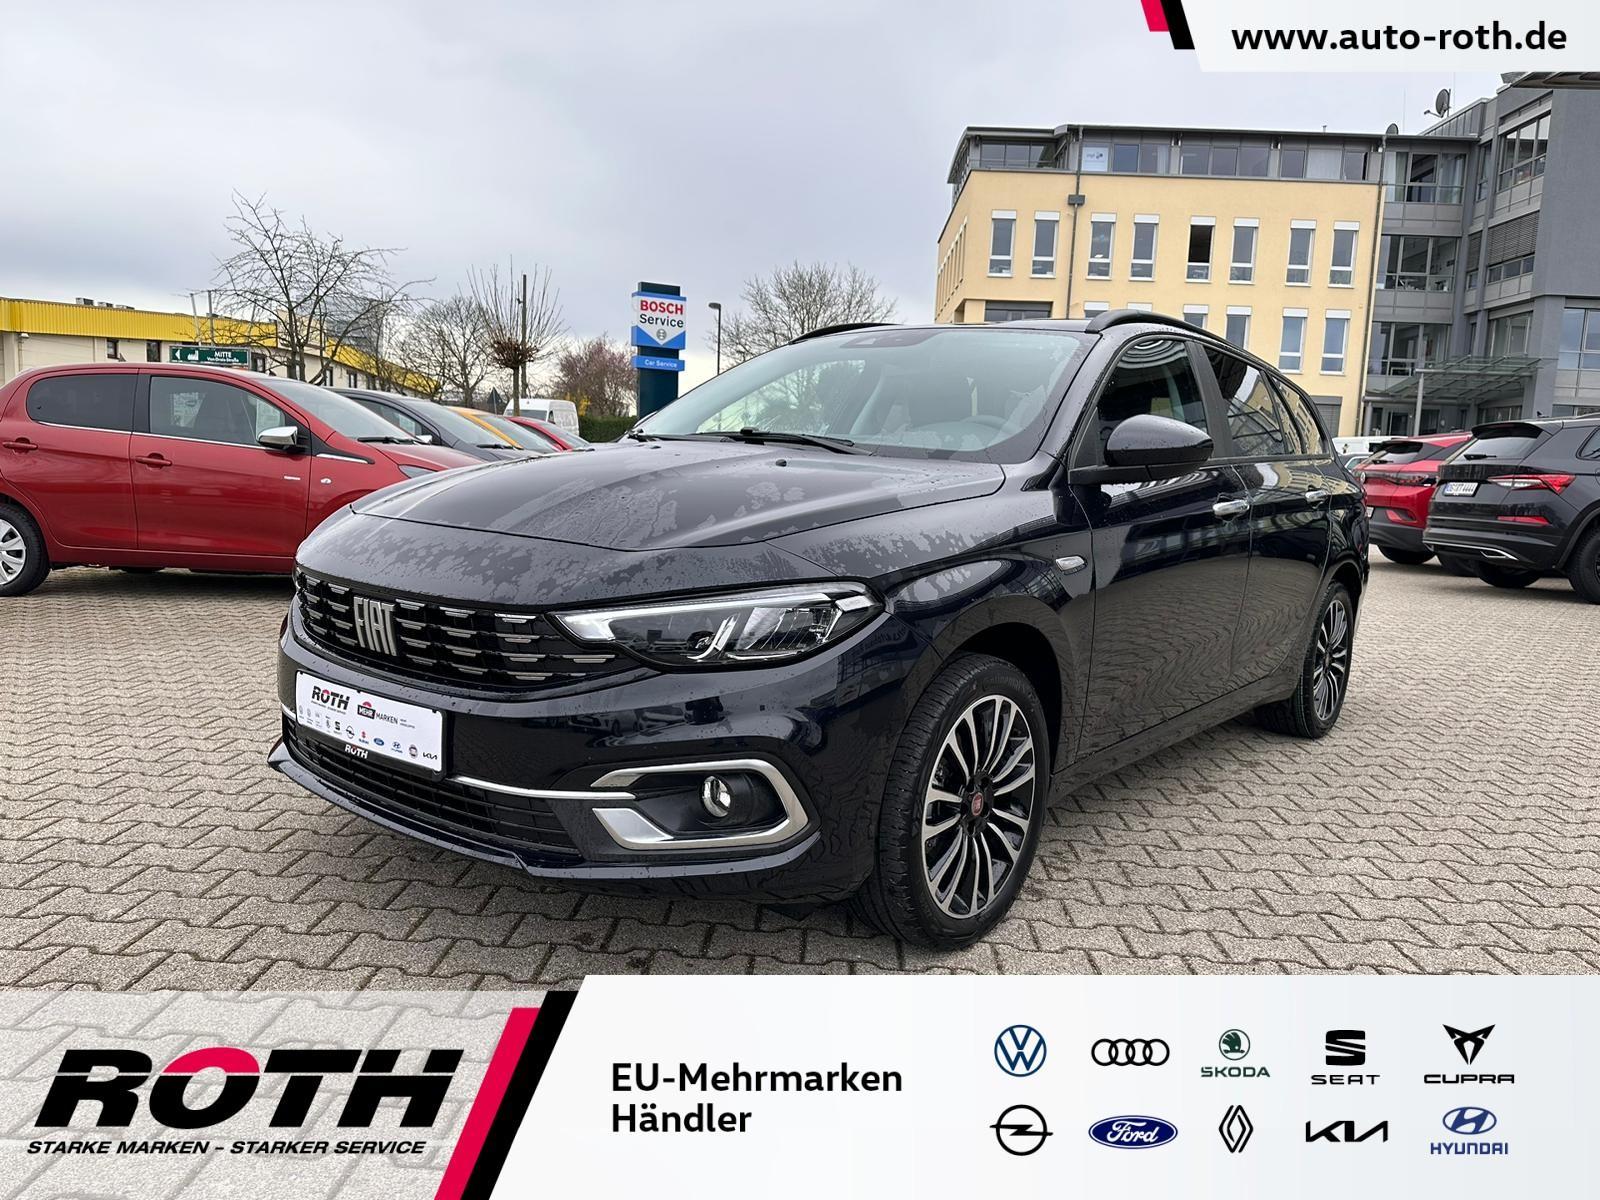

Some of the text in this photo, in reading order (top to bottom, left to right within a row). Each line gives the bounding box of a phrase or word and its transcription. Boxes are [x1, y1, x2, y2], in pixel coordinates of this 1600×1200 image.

[640, 300, 683, 315] BOSCH
[639, 313, 684, 328] Service
[656, 360, 678, 368] Service
[353, 596, 397, 657] FIAT
[312, 685, 350, 710] ROTH
[345, 744, 369, 759] ROTH
